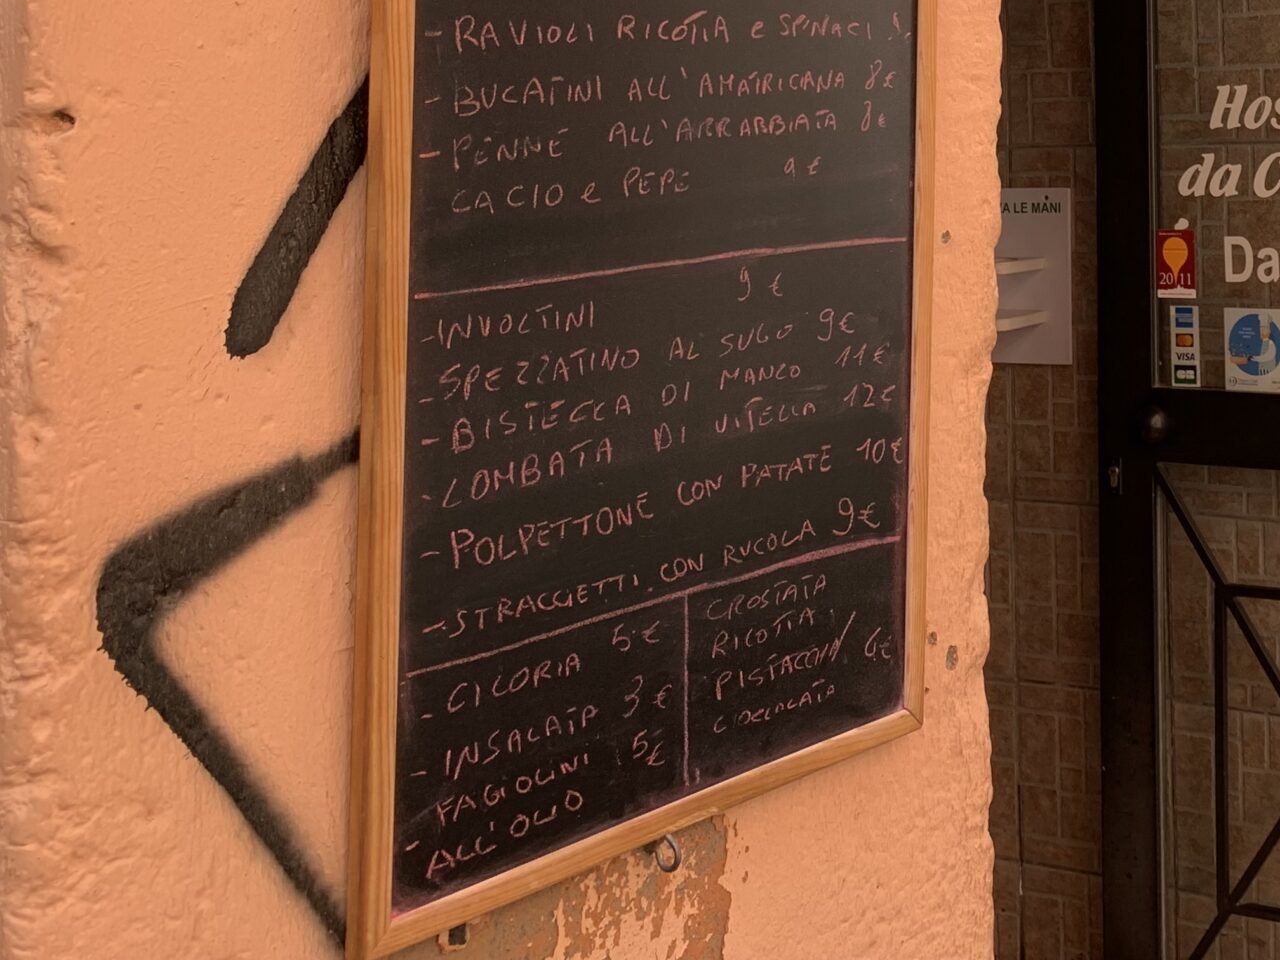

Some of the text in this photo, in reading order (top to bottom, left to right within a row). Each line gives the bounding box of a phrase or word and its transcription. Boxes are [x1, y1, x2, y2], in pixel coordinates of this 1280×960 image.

[454, 15, 594, 54] RAVIOLI
[454, 75, 602, 117] BUCATINI
[451, 182, 564, 214] CACIO
[623, 166, 690, 197] PEPE
[1178, 153, 1242, 197] da
[1013, 202, 1028, 214] LE
[1031, 202, 1061, 214] MANI
[438, 299, 596, 349] INVOLTINI
[439, 346, 642, 403] SPEZZATINO
[669, 336, 701, 361] AL
[1176, 352, 1195, 361] VISA
[451, 393, 632, 454] BISTECCA
[661, 380, 690, 406] DI
[720, 363, 801, 391] MANZO
[442, 438, 615, 509] LOMBATA
[653, 425, 686, 455] DI
[450, 492, 655, 569] POLPETTONE
[676, 473, 723, 507] CON
[741, 444, 833, 488] PATATE
[659, 553, 705, 584] CON
[723, 519, 817, 567] RUCOLA
[707, 573, 828, 622] CROSTATA
[447, 652, 582, 713] CICORIA
[436, 755, 590, 828] FAGIOLINI
